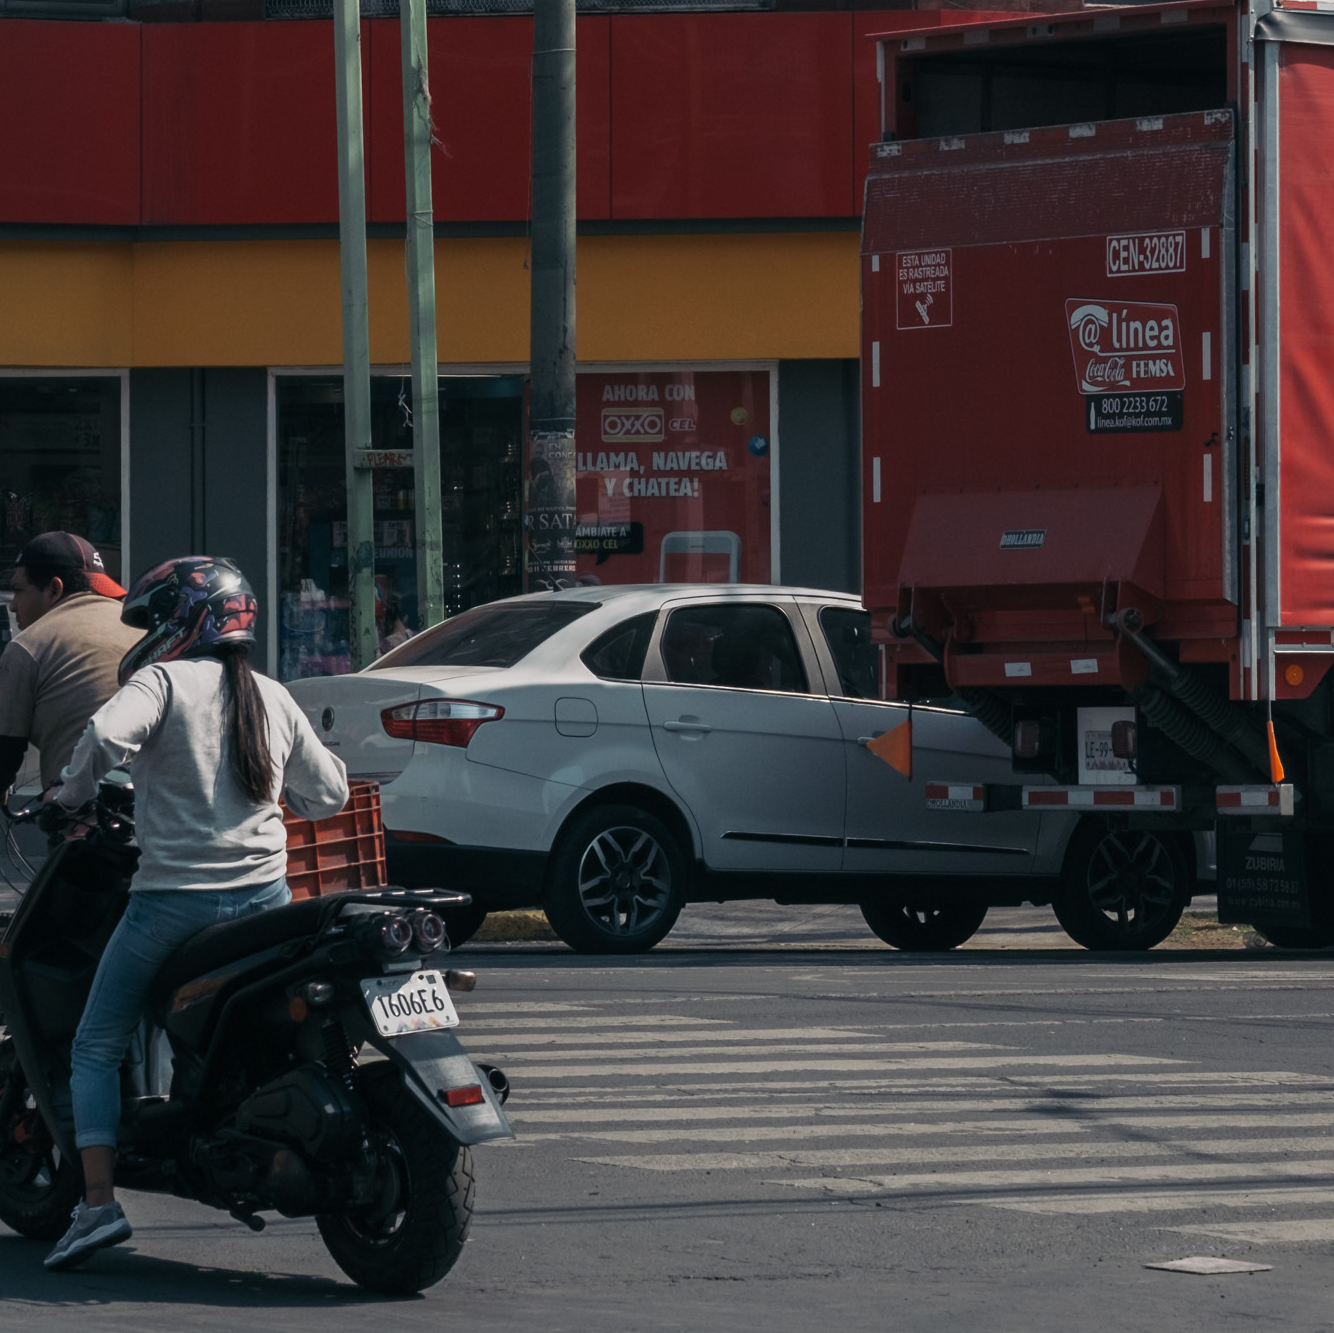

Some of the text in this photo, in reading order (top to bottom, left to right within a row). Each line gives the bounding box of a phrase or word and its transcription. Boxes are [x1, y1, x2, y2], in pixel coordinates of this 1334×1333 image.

[903, 253, 946, 267] ESTA UNIDAD
[1109, 235, 1183, 272] CEN-32887
[899, 266, 949, 280] ES RASTREADA
[916, 279, 945, 293] SATÉLITE
[1112, 309, 1174, 349] línea
[1132, 359, 1175, 378] FEMSA
[602, 385, 695, 401] AHORA CON
[1102, 396, 1168, 414] 800 2233 672
[604, 414, 696, 435] OXXO CEL
[577, 451, 728, 474] LLAMA, NAVEGA
[604, 477, 699, 498] Y CHATEA!
[619, 526, 627, 537] A
[574, 538, 600, 549] OXXO
[603, 538, 619, 549] CEL
[1245, 856, 1286, 872] ZUBIRIA
